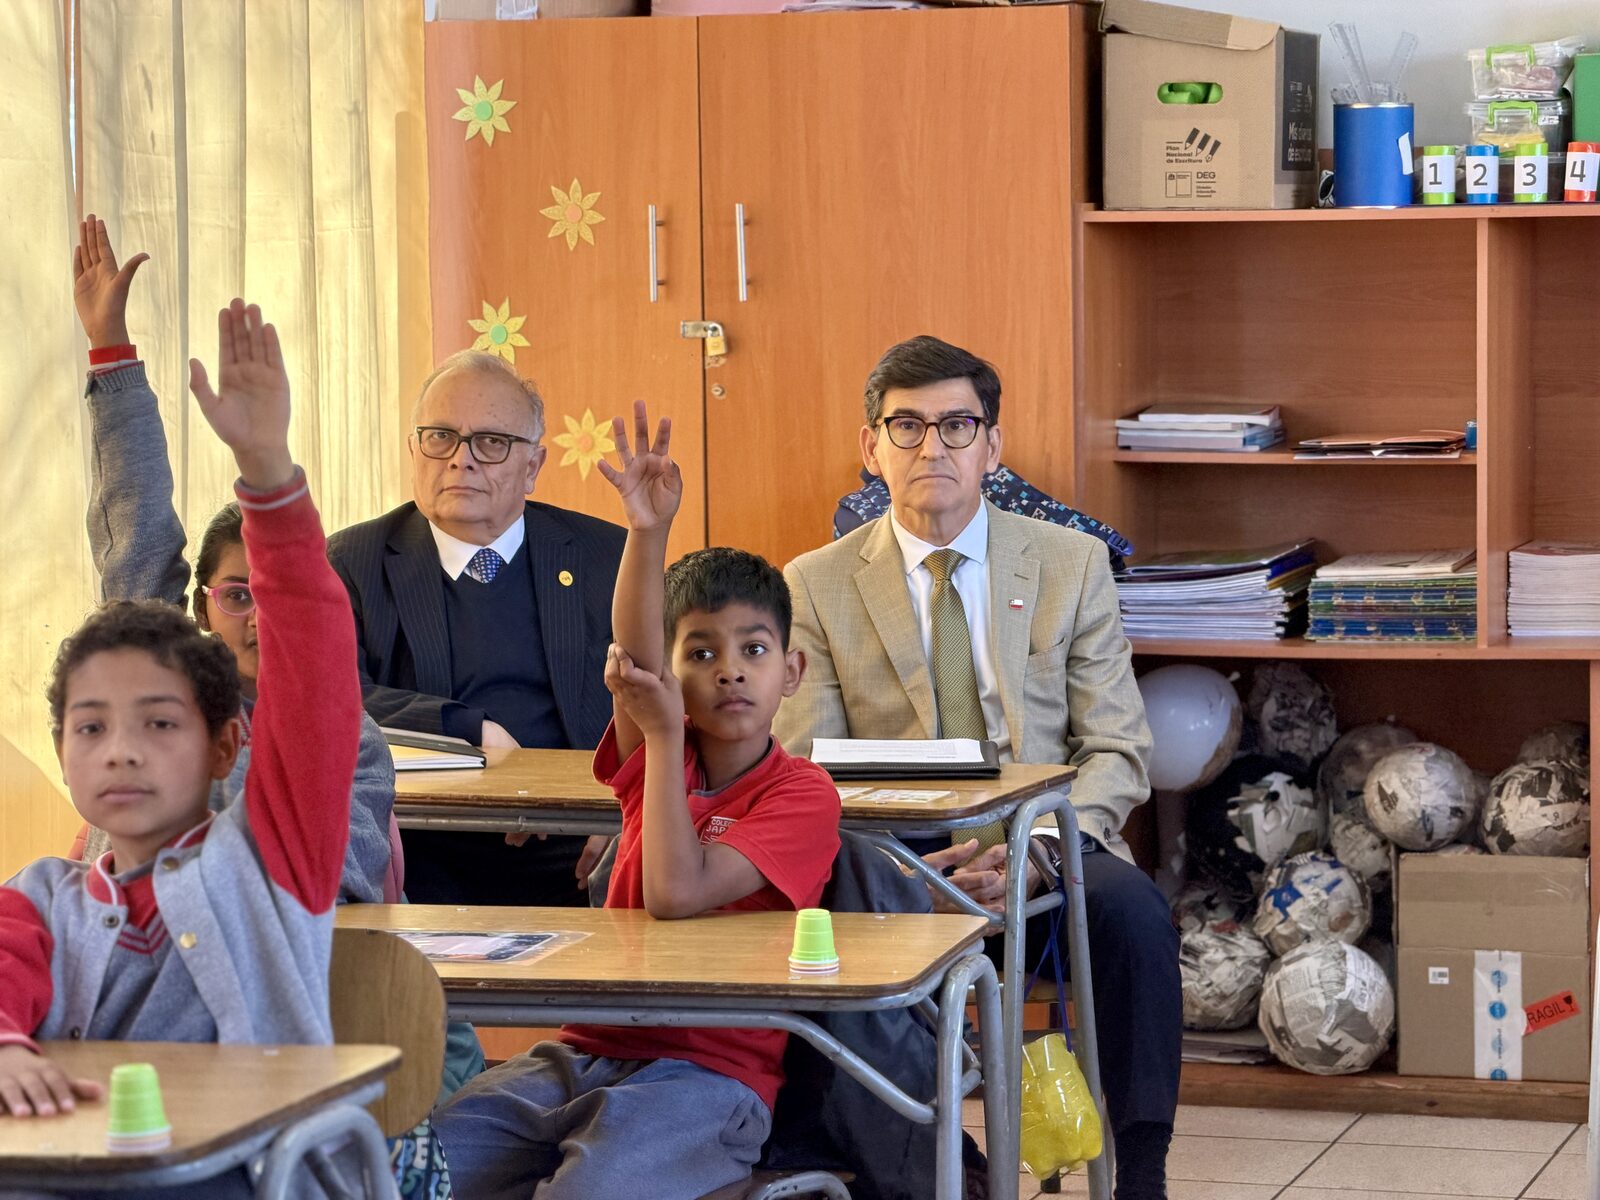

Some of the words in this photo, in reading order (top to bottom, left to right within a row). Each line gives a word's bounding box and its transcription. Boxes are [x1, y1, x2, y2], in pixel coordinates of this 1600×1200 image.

[1196, 171, 1216, 179] DEG
[1428, 163, 1443, 186] 1
[1473, 163, 1488, 186] 2
[1522, 163, 1537, 187] 3
[1570, 160, 1587, 183] 4
[1526, 1002, 1566, 1026] RAGIL
